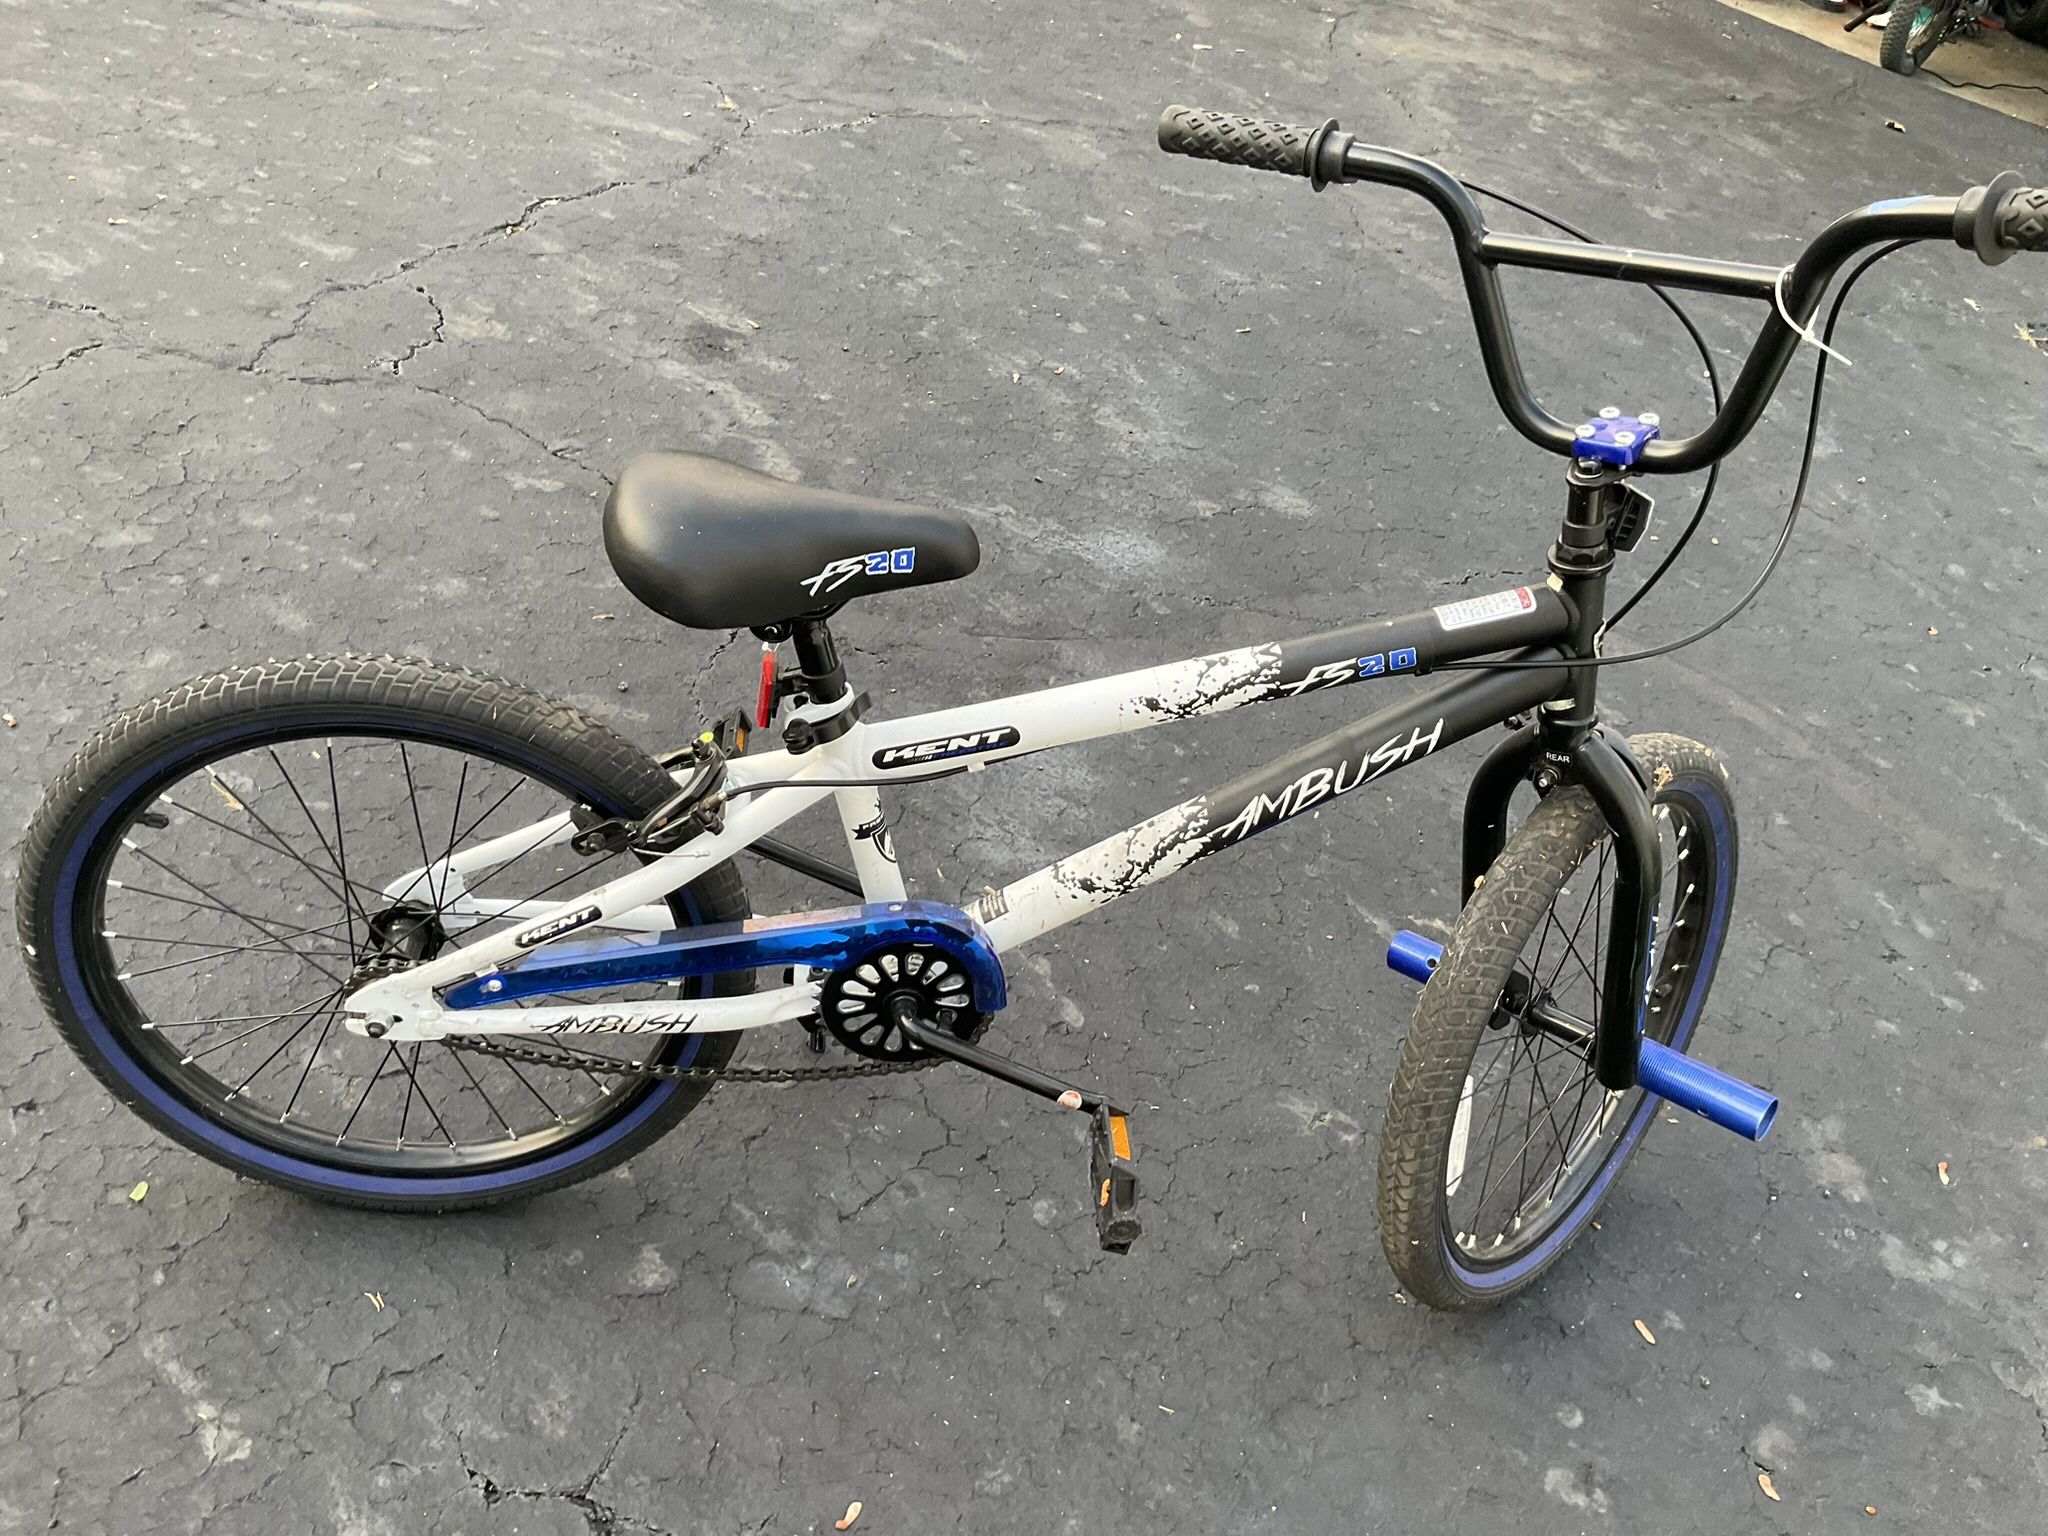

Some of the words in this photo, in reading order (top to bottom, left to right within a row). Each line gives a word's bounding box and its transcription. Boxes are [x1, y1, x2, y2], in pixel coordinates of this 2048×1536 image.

[800, 546, 915, 597] FS20
[1280, 647, 1417, 697] FS20
[882, 727, 1012, 763] KENT
[1546, 752, 1571, 764] REAR
[1206, 717, 1445, 840] AMBUSH
[521, 906, 596, 944] KENT
[530, 1013, 698, 1034] AMBUSH
